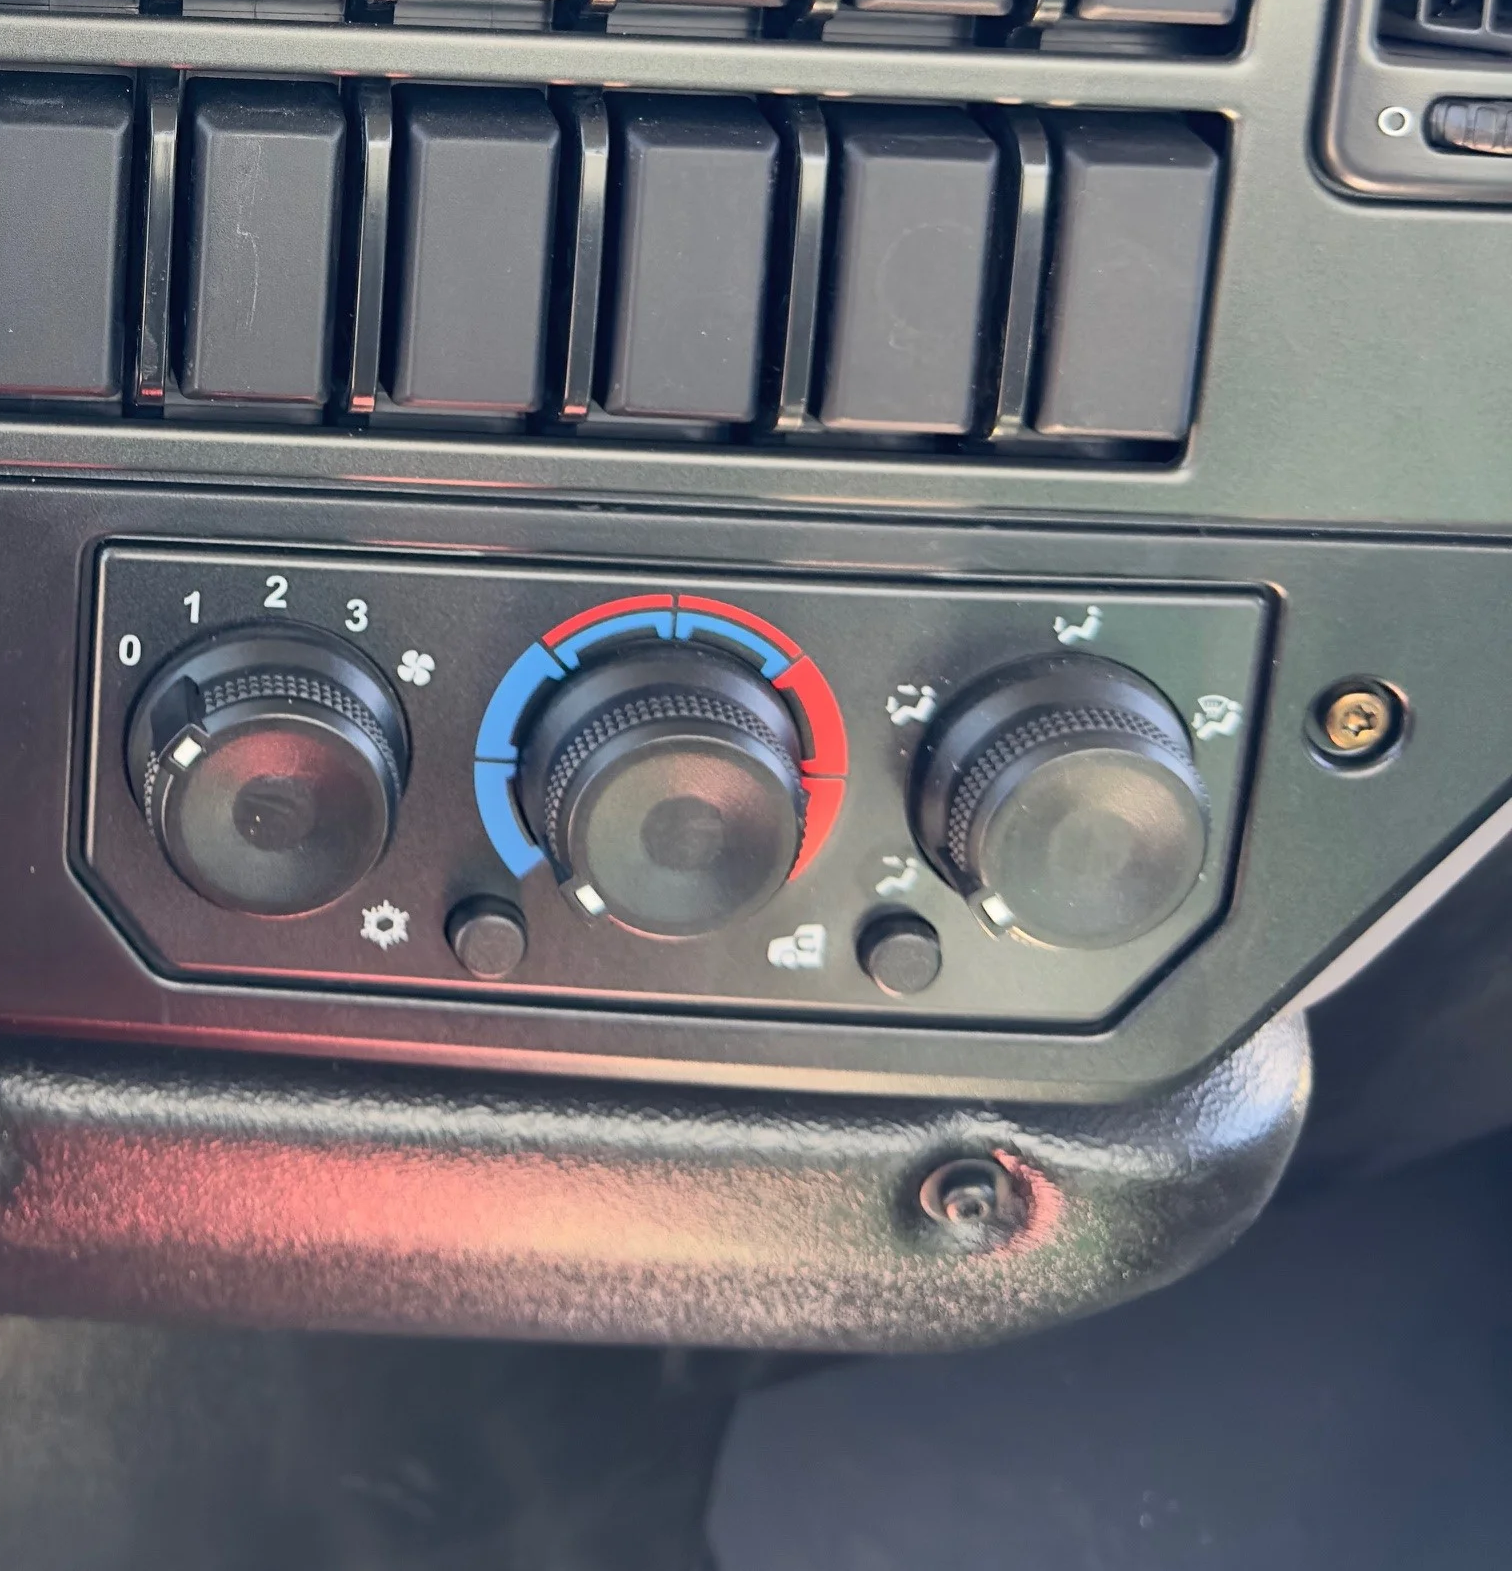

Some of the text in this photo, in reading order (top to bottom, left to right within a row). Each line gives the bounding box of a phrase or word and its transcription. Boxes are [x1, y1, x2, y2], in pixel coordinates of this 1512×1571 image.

[183, 591, 200, 623] 1
[263, 575, 288, 608] 2
[345, 598, 369, 632] 3
